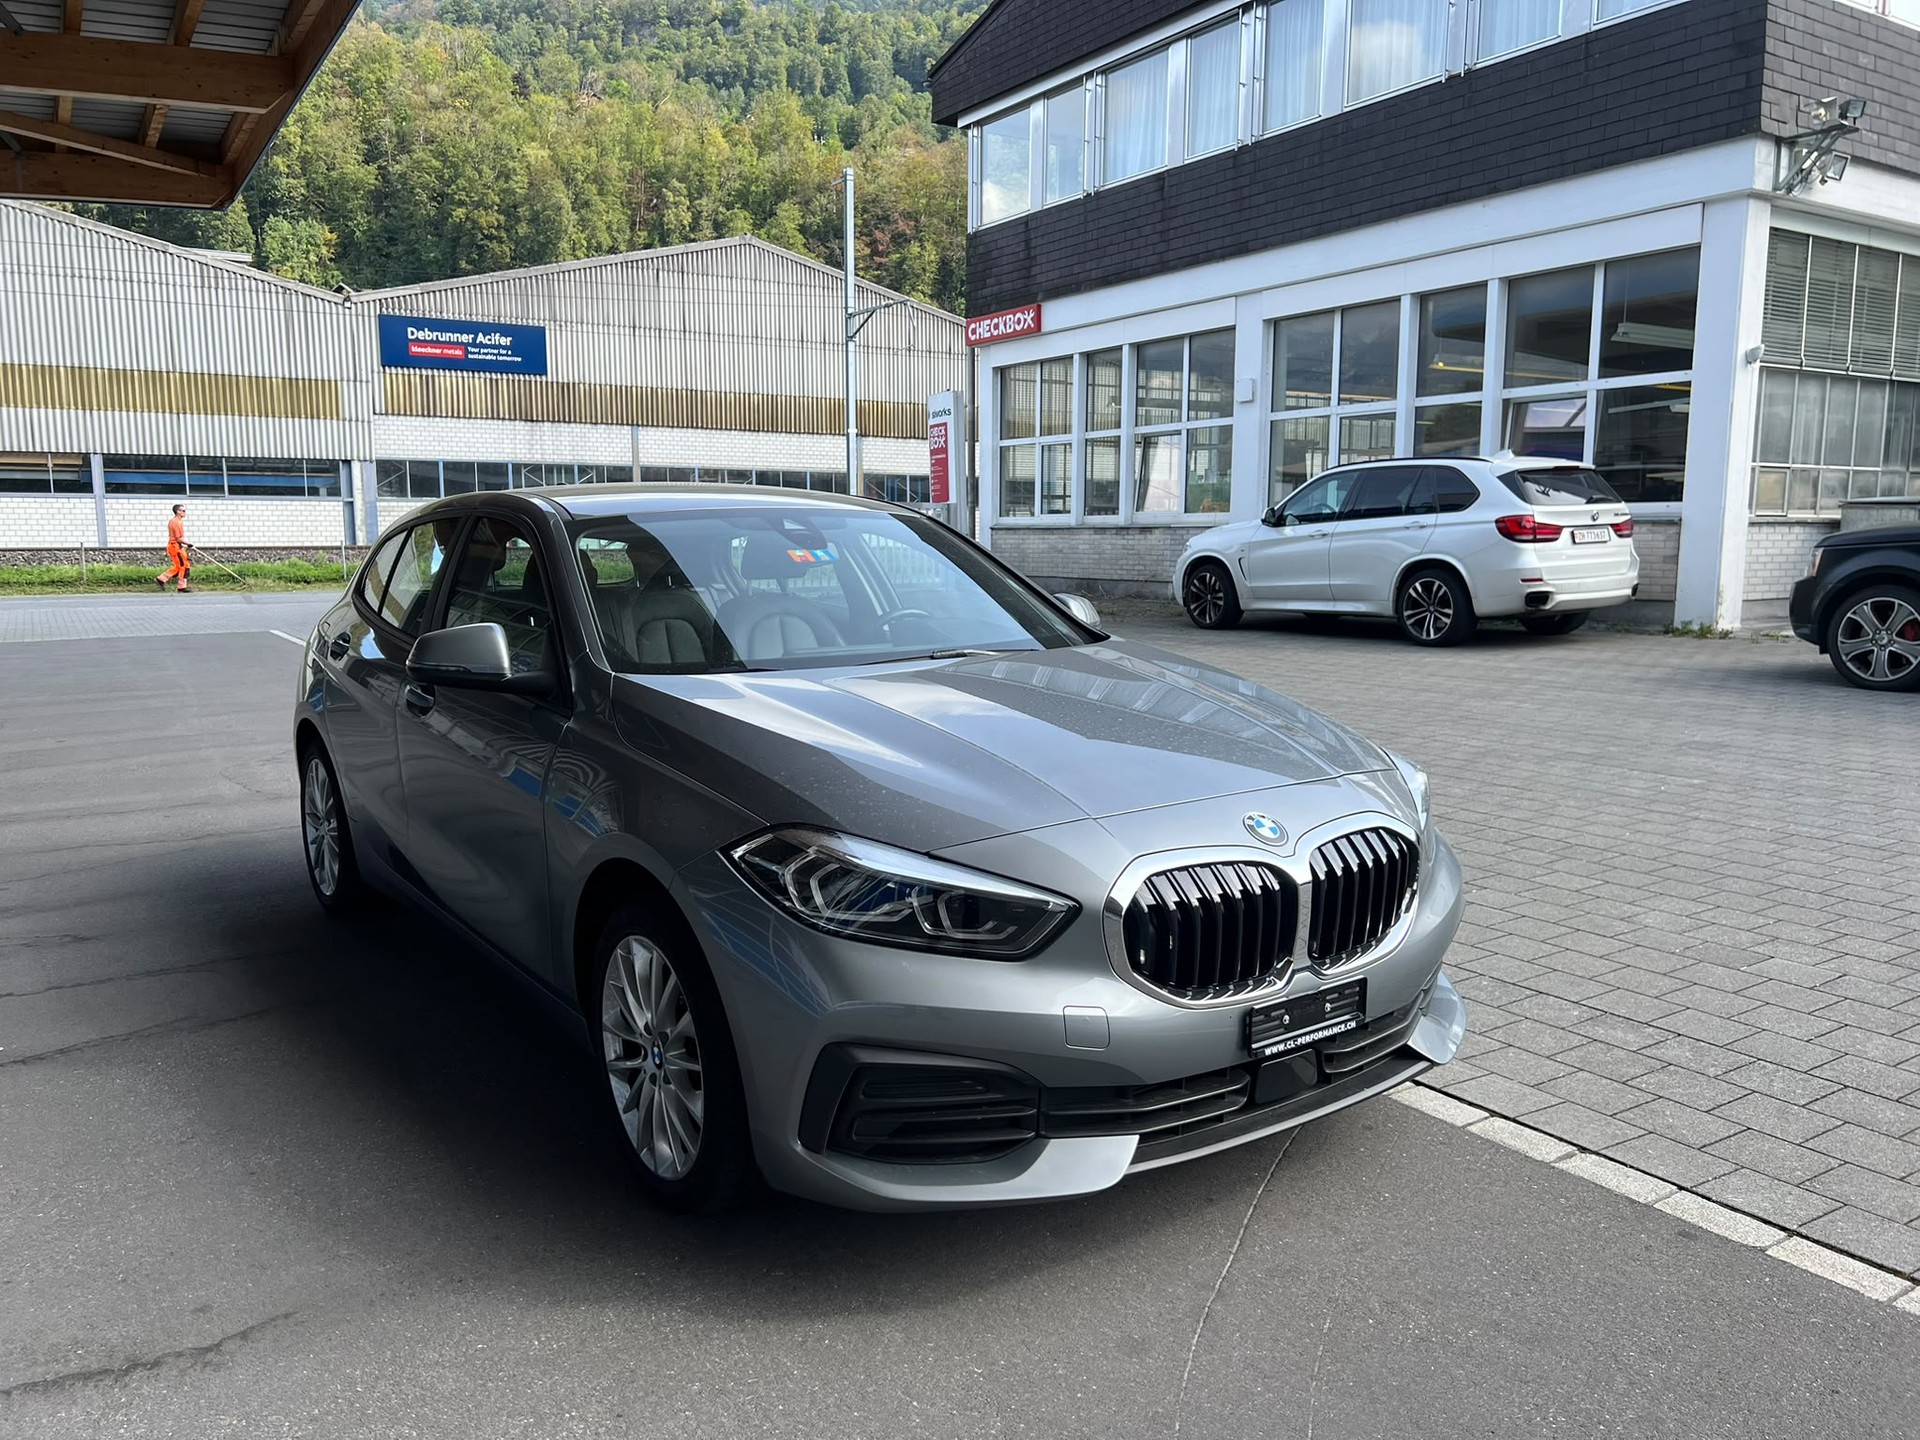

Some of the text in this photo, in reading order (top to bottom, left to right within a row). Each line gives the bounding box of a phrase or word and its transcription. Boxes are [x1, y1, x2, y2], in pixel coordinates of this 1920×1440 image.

[407, 327, 513, 346] Debrunner Acifer
[968, 309, 1035, 341] CHECKBOX
[467, 353, 497, 361] sustainable
[1264, 1020, 1357, 1056] WWW.CL-PERFORMANCE.CH
